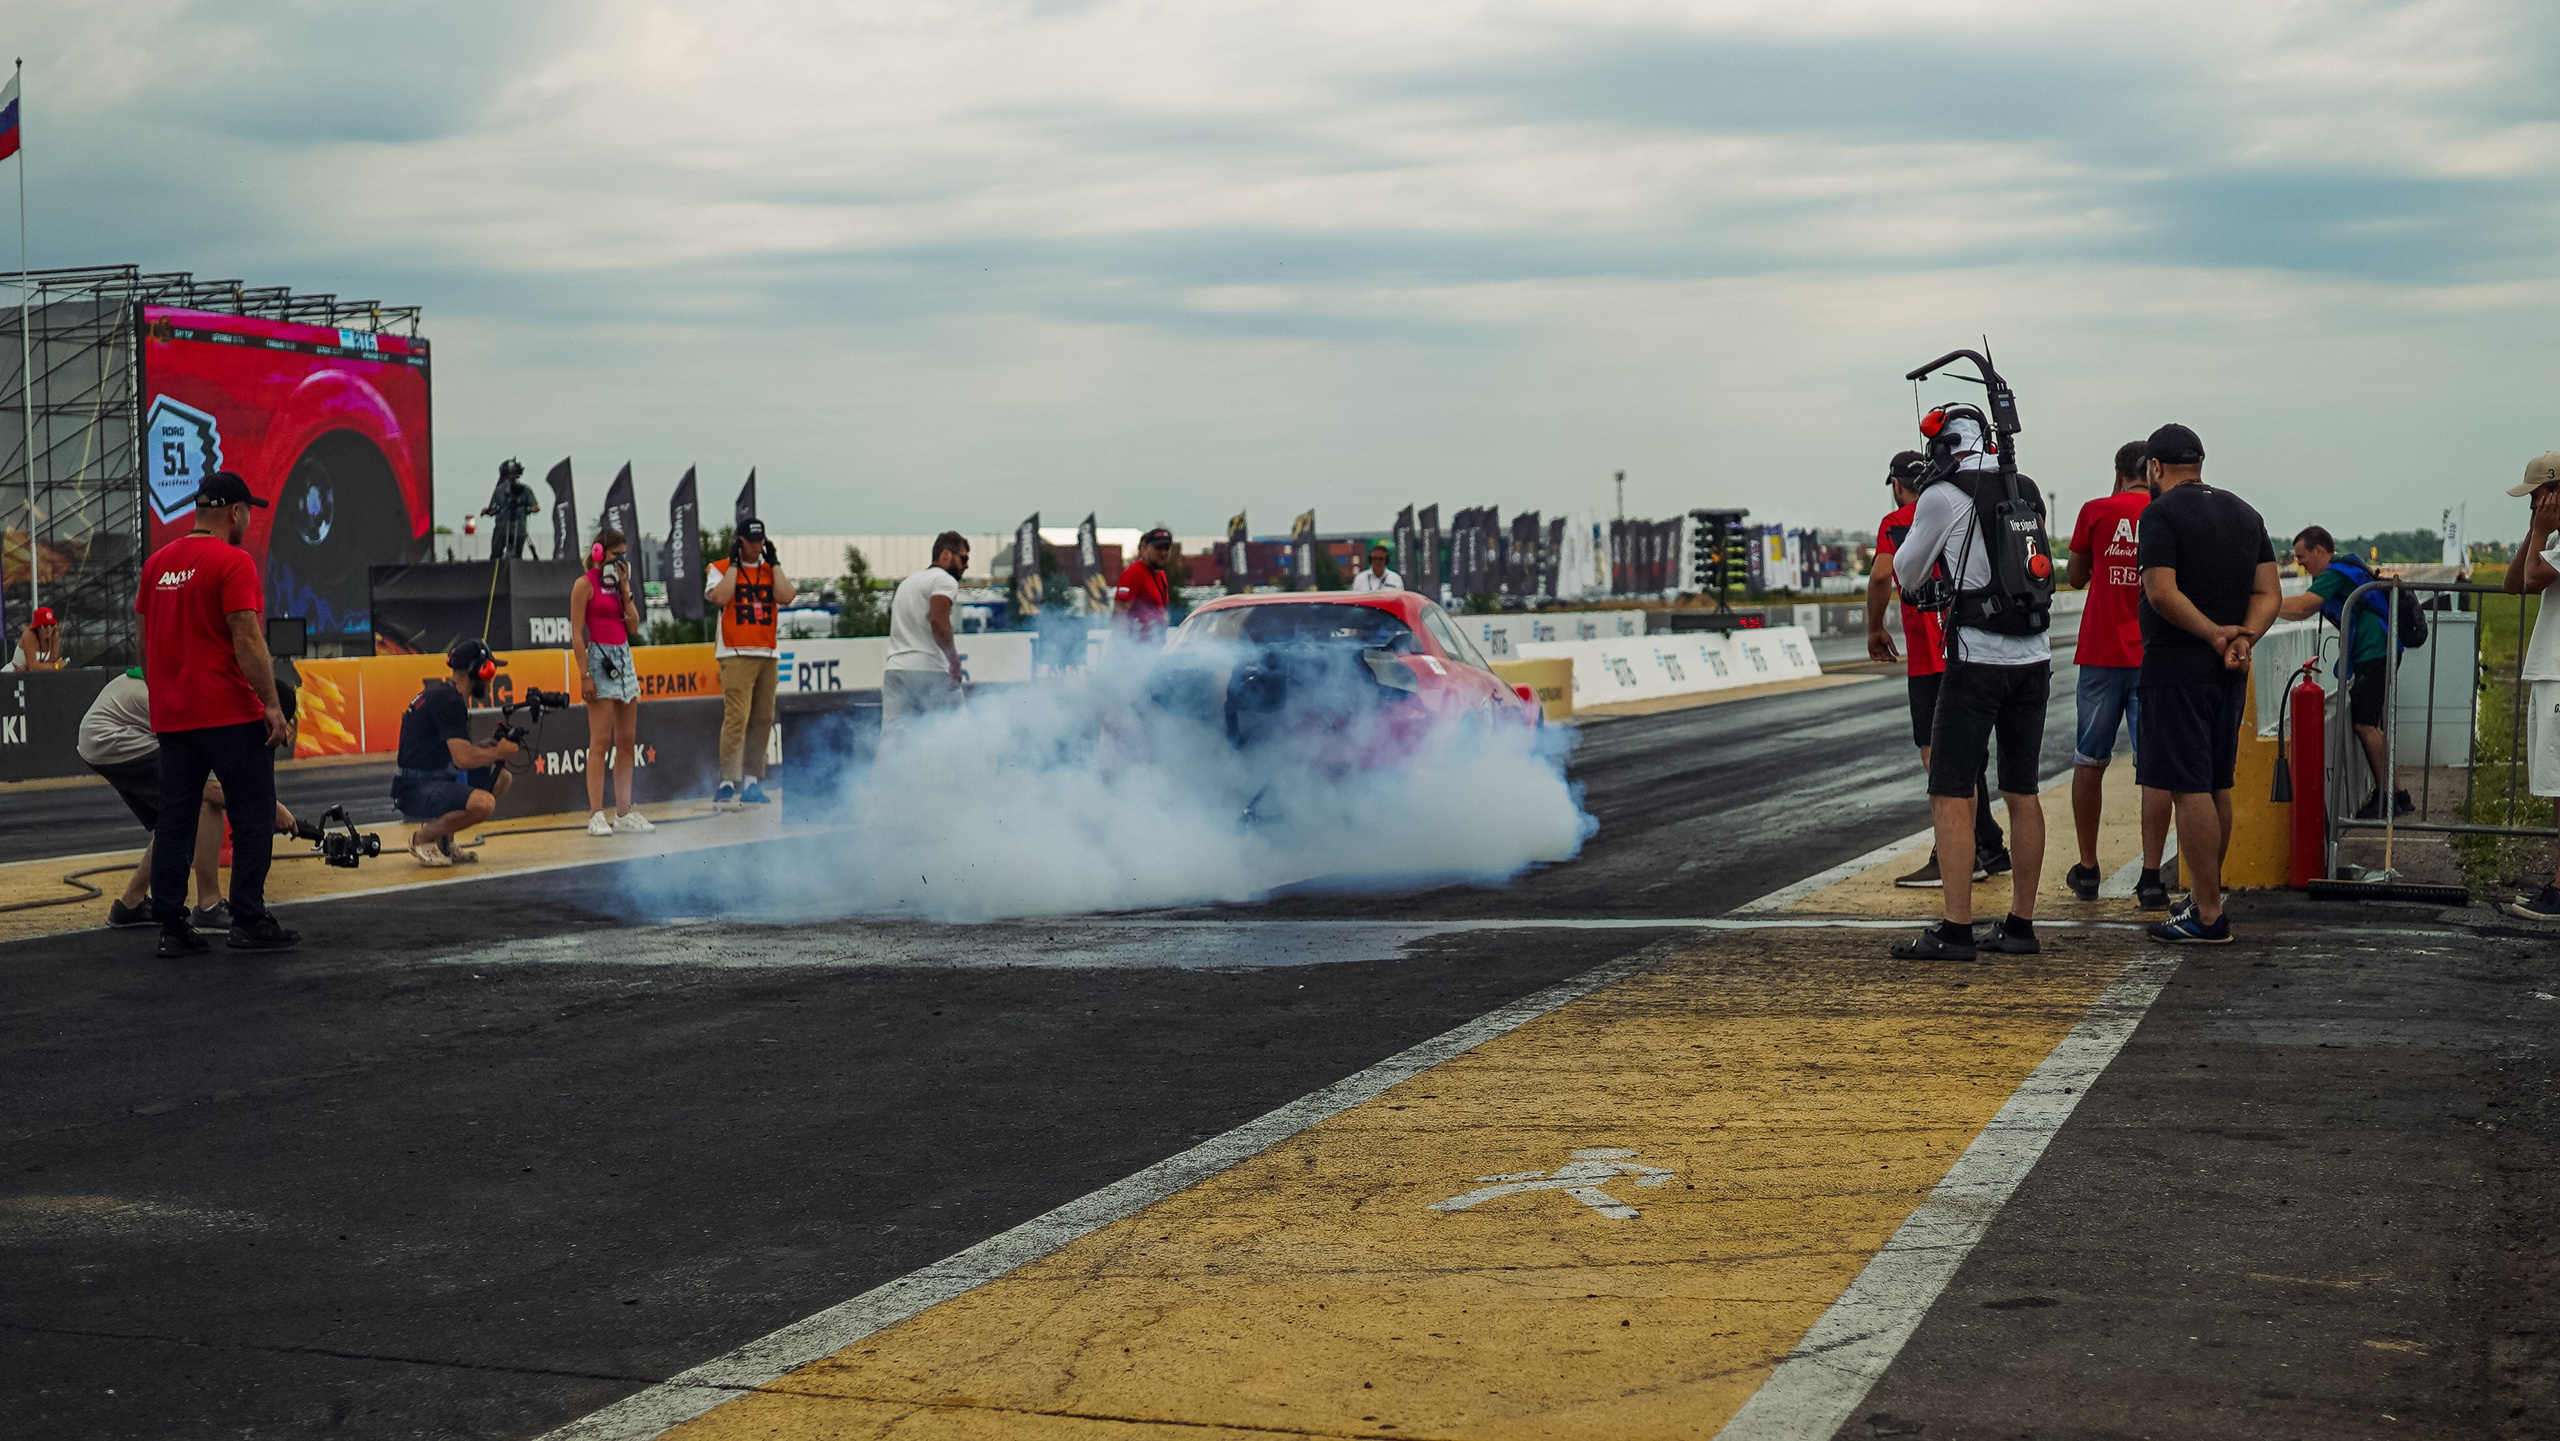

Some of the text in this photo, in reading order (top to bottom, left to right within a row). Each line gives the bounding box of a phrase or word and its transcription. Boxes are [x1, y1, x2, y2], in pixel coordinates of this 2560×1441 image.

[163, 442, 190, 475] 51
[2547, 468, 2556, 480] 3
[2020, 517, 2038, 532] signal
[2112, 518, 2140, 543] A
[2109, 566, 2142, 586] RD
[2, 715, 27, 744] KI
